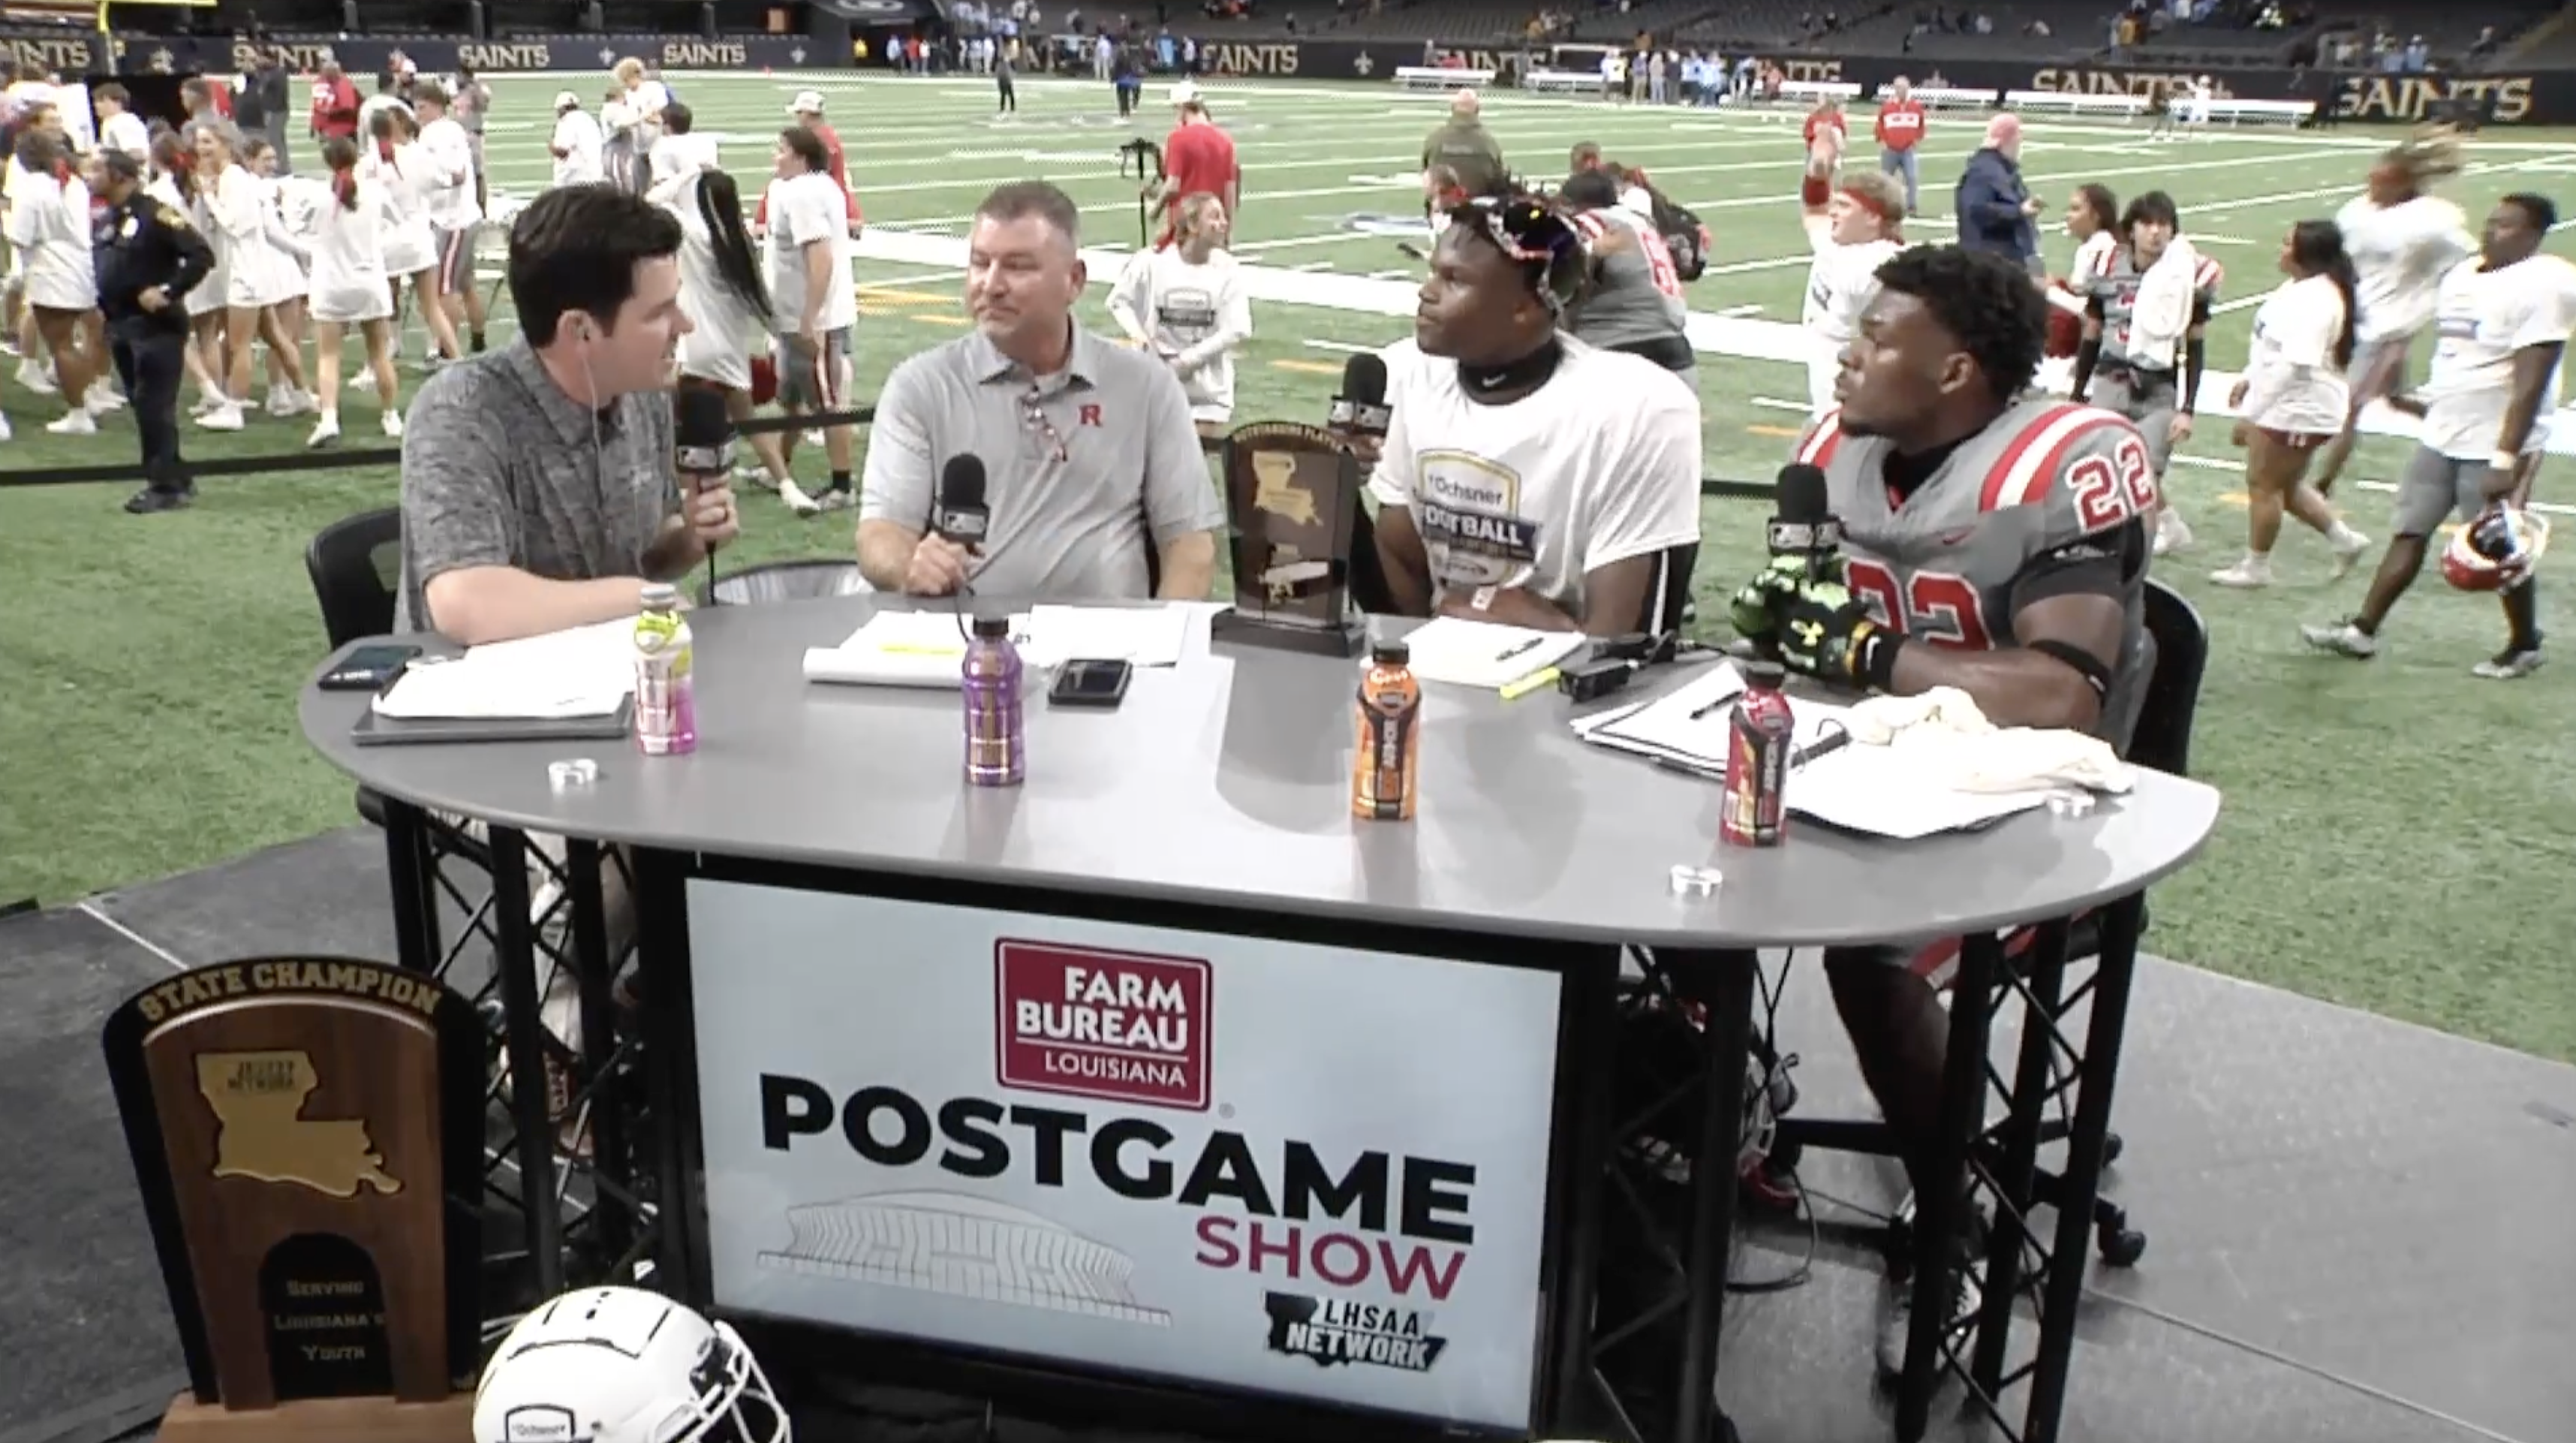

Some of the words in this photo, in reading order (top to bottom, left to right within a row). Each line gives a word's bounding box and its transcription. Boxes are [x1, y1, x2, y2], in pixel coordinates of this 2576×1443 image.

[458, 44, 549, 68] SAINTS
[664, 43, 747, 66] SAINTS
[1079, 404, 1103, 428] R
[1435, 475, 1503, 505] Ochsner
[2066, 435, 2157, 535] 22
[1842, 556, 1995, 652] 22
[139, 968, 247, 1022] STATE
[251, 961, 442, 1014] CHAMPION
[1064, 966, 1187, 1014] FARM
[1016, 999, 1188, 1051] BUREAU
[1046, 1050, 1187, 1089] LOUISIANA
[760, 1072, 1476, 1244] POSTGAME
[1196, 1216, 1467, 1300] SHOW
[1323, 1299, 1419, 1336] LHSAA
[1286, 1321, 1431, 1369] NETWORK
